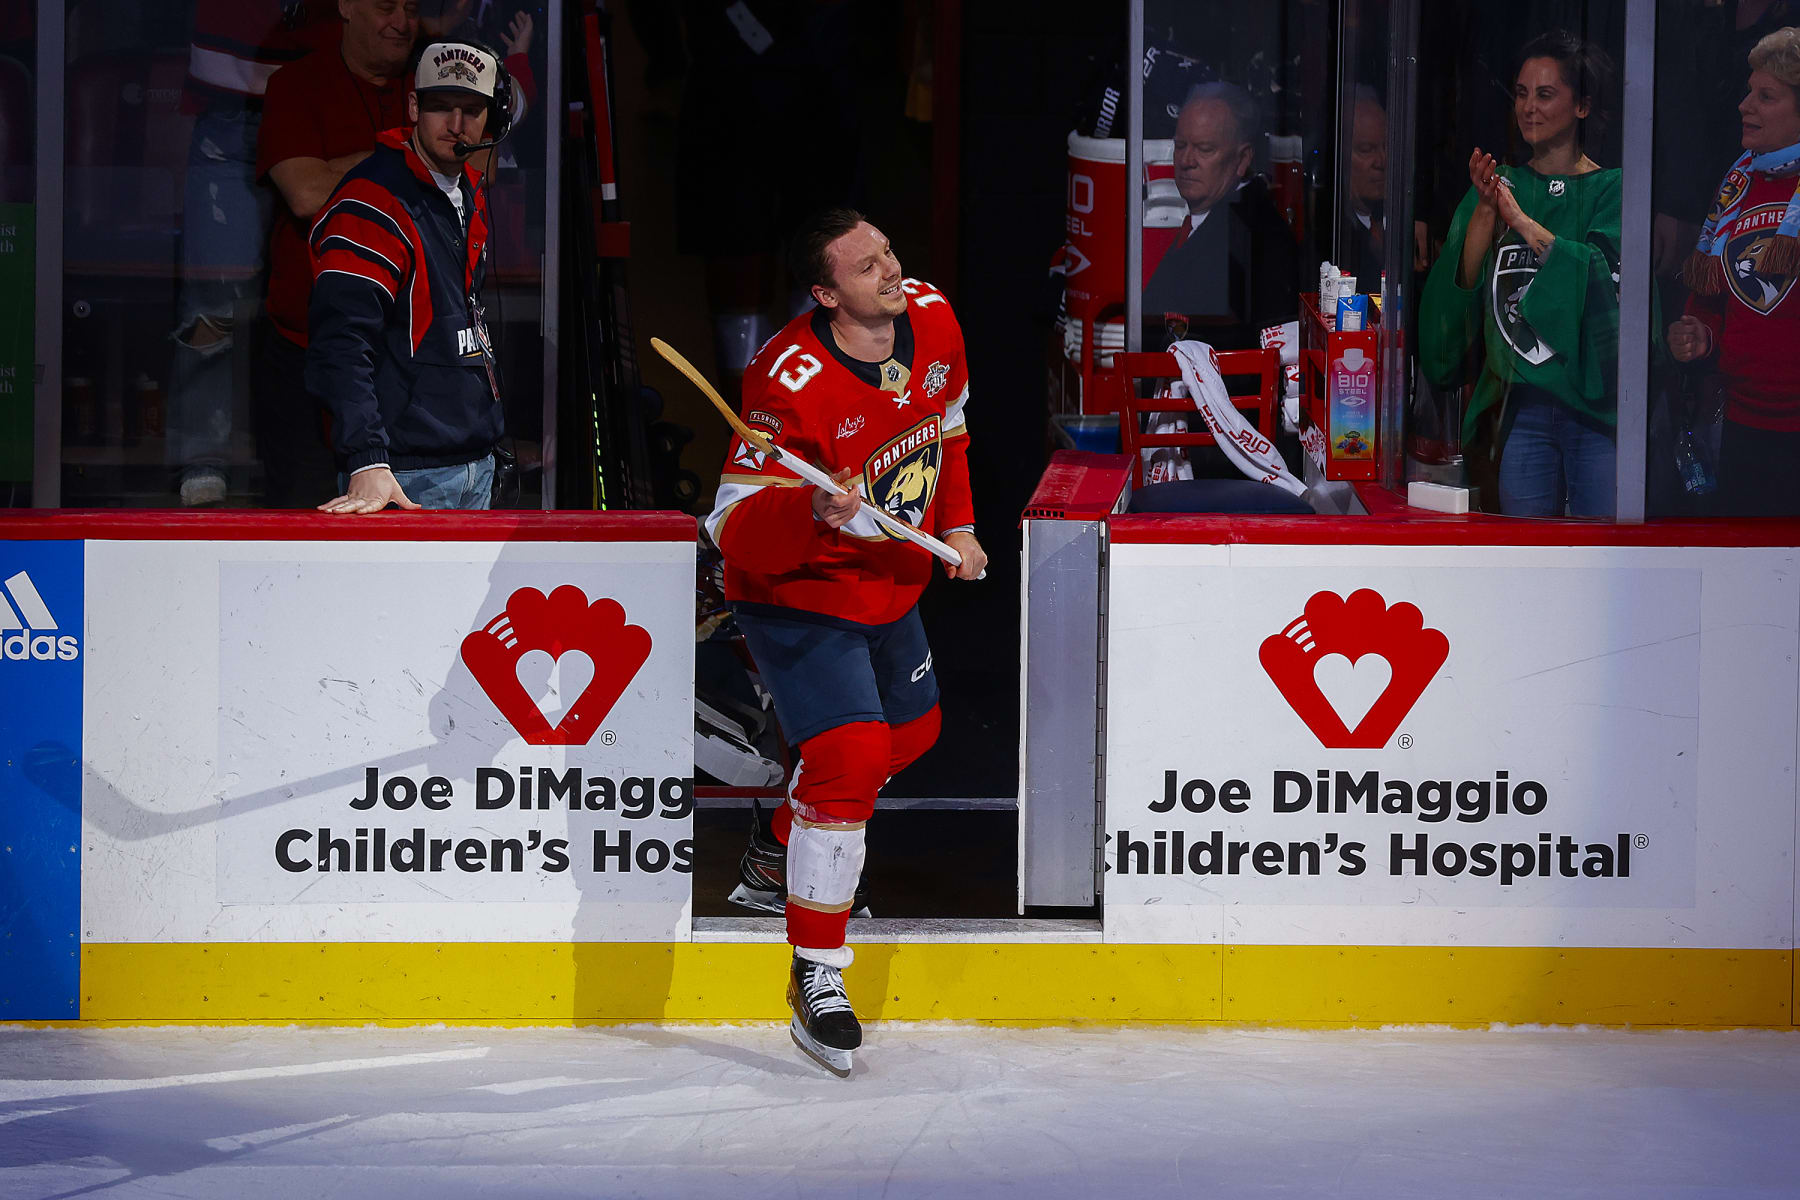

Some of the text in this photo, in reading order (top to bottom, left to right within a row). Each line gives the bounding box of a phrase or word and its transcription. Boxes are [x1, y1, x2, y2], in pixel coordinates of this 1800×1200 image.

[433, 48, 486, 73] PANTHERS
[768, 344, 823, 392] 13
[1338, 374, 1368, 388] BIO
[753, 413, 780, 430] FLORIDA
[873, 423, 936, 477] PANTHERS
[349, 766, 694, 819] Joe DiMagg
[1149, 770, 1547, 823] Joe DiMaggio
[275, 828, 569, 873] Children’s
[1105, 830, 1366, 876] hildren’s
